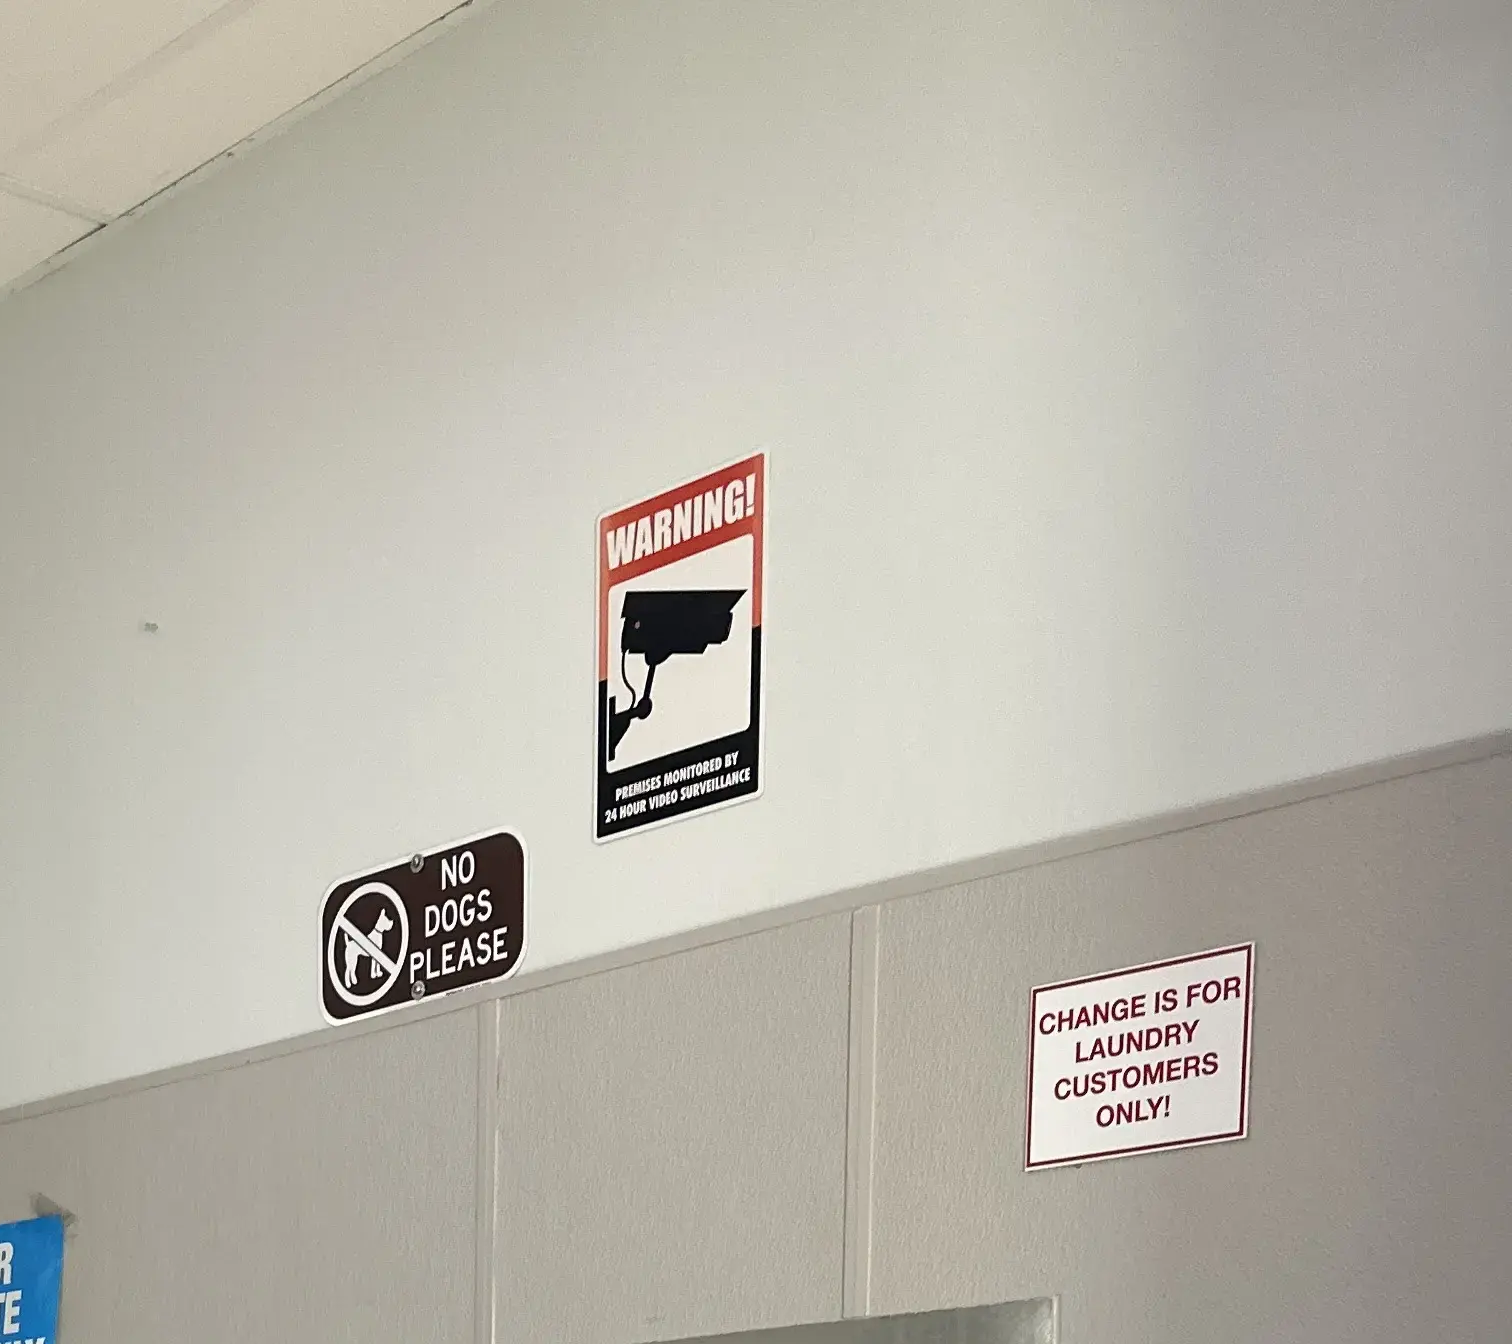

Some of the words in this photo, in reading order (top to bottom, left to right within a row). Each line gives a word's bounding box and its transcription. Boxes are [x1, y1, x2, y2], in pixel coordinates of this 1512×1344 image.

[606, 472, 756, 570] WARNING!
[605, 808, 617, 823] 24
[619, 799, 646, 819] HOUR
[649, 789, 678, 810] VIDEO
[680, 767, 750, 801] SURVEILLANCE
[615, 775, 661, 801] PREMISES
[663, 757, 722, 787] MONITORED
[724, 750, 739, 768] BY
[441, 850, 475, 890] NO
[424, 888, 493, 938] DOGS
[409, 926, 508, 984] PLEASE
[1039, 994, 1146, 1035] CHANGE
[1154, 988, 1178, 1014] IS
[1186, 976, 1241, 1008] FOR
[1075, 1019, 1200, 1063] LAUNDRY
[1054, 1052, 1219, 1100] CUSTOMERS
[1096, 1095, 1170, 1128] ONLY!
